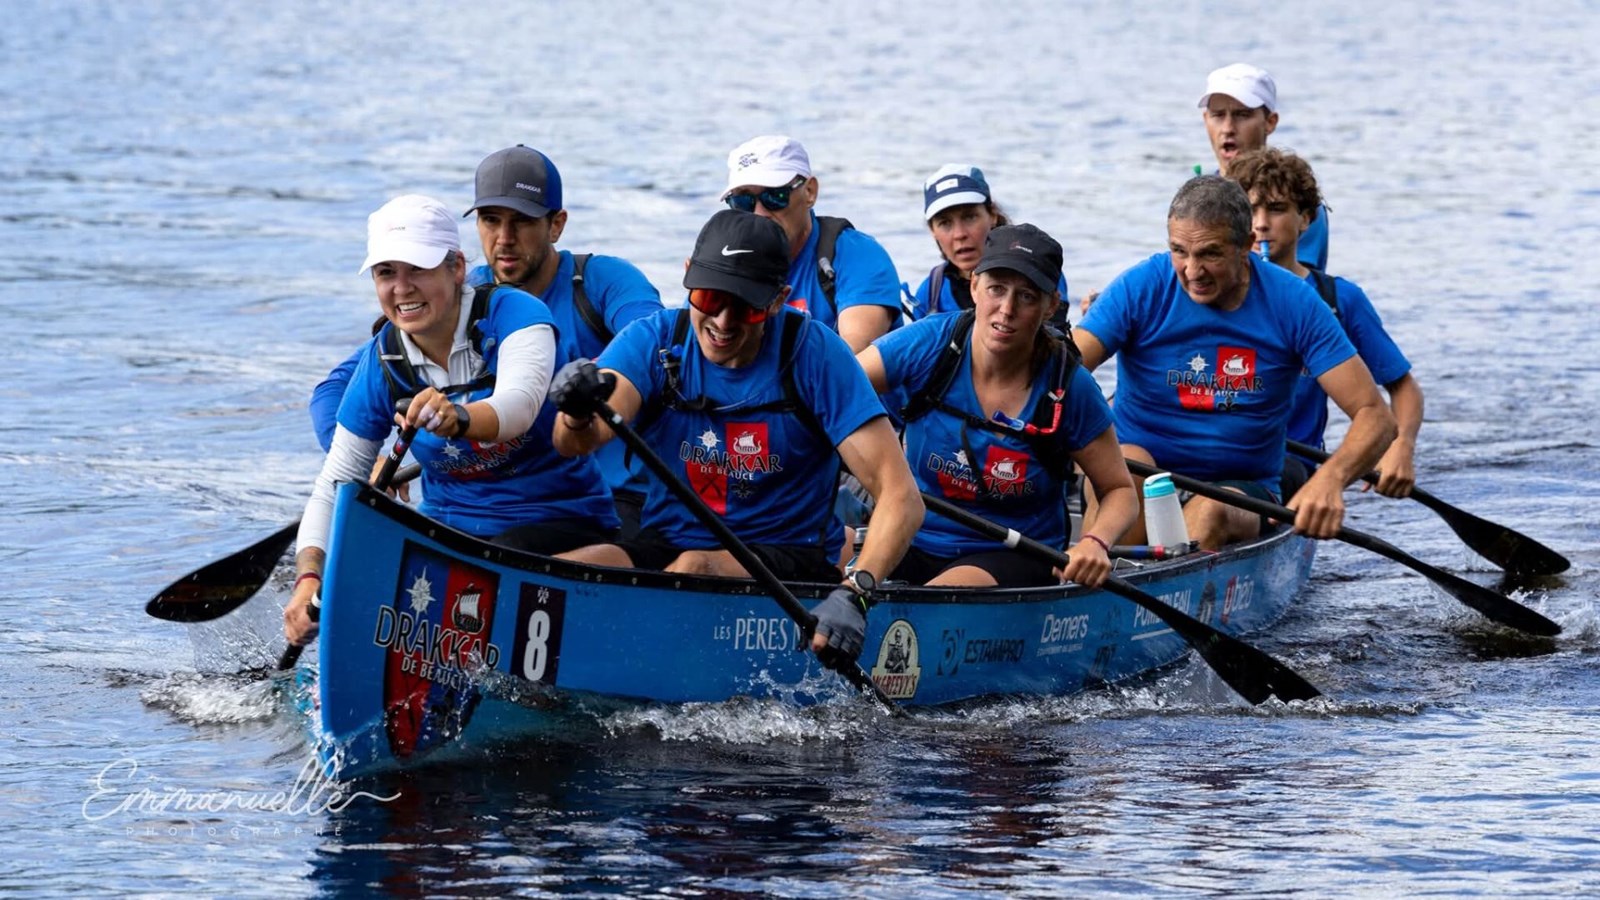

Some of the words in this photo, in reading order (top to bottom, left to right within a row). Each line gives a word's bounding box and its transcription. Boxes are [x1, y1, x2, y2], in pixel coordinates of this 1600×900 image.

[1167, 370, 1265, 393] DRAKKAR
[1190, 387, 1201, 395] DE
[1204, 388, 1239, 398] BEAUCE
[680, 441, 783, 474] DRAKKAR
[700, 466, 713, 474] DE
[717, 468, 755, 481] BEAUCE
[713, 625, 732, 640] LES
[1040, 613, 1089, 643] Demers
[523, 610, 550, 681] 8
[965, 638, 1025, 664] ESTAMPRO
[401, 657, 418, 675] DE
